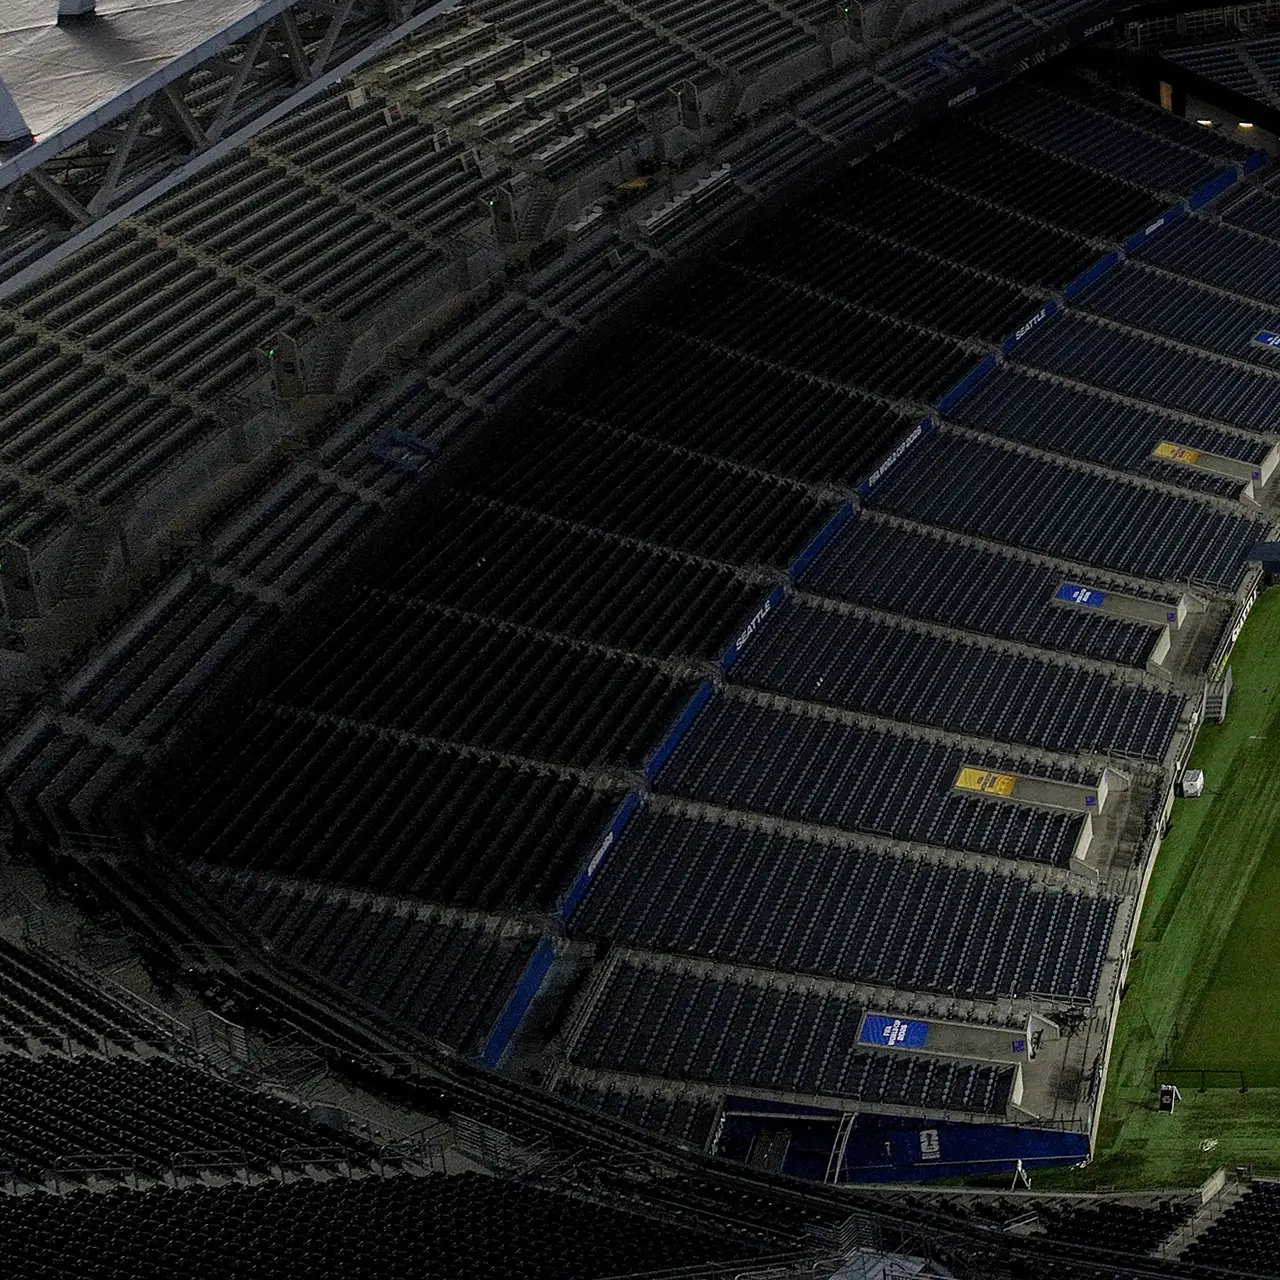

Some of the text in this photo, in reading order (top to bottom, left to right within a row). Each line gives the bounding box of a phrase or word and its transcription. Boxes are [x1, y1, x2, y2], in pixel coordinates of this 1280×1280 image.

[1083, 17, 1115, 37] SEATTLE
[1015, 309, 1046, 341] SEATTLE
[736, 600, 771, 651] SEATTLE
